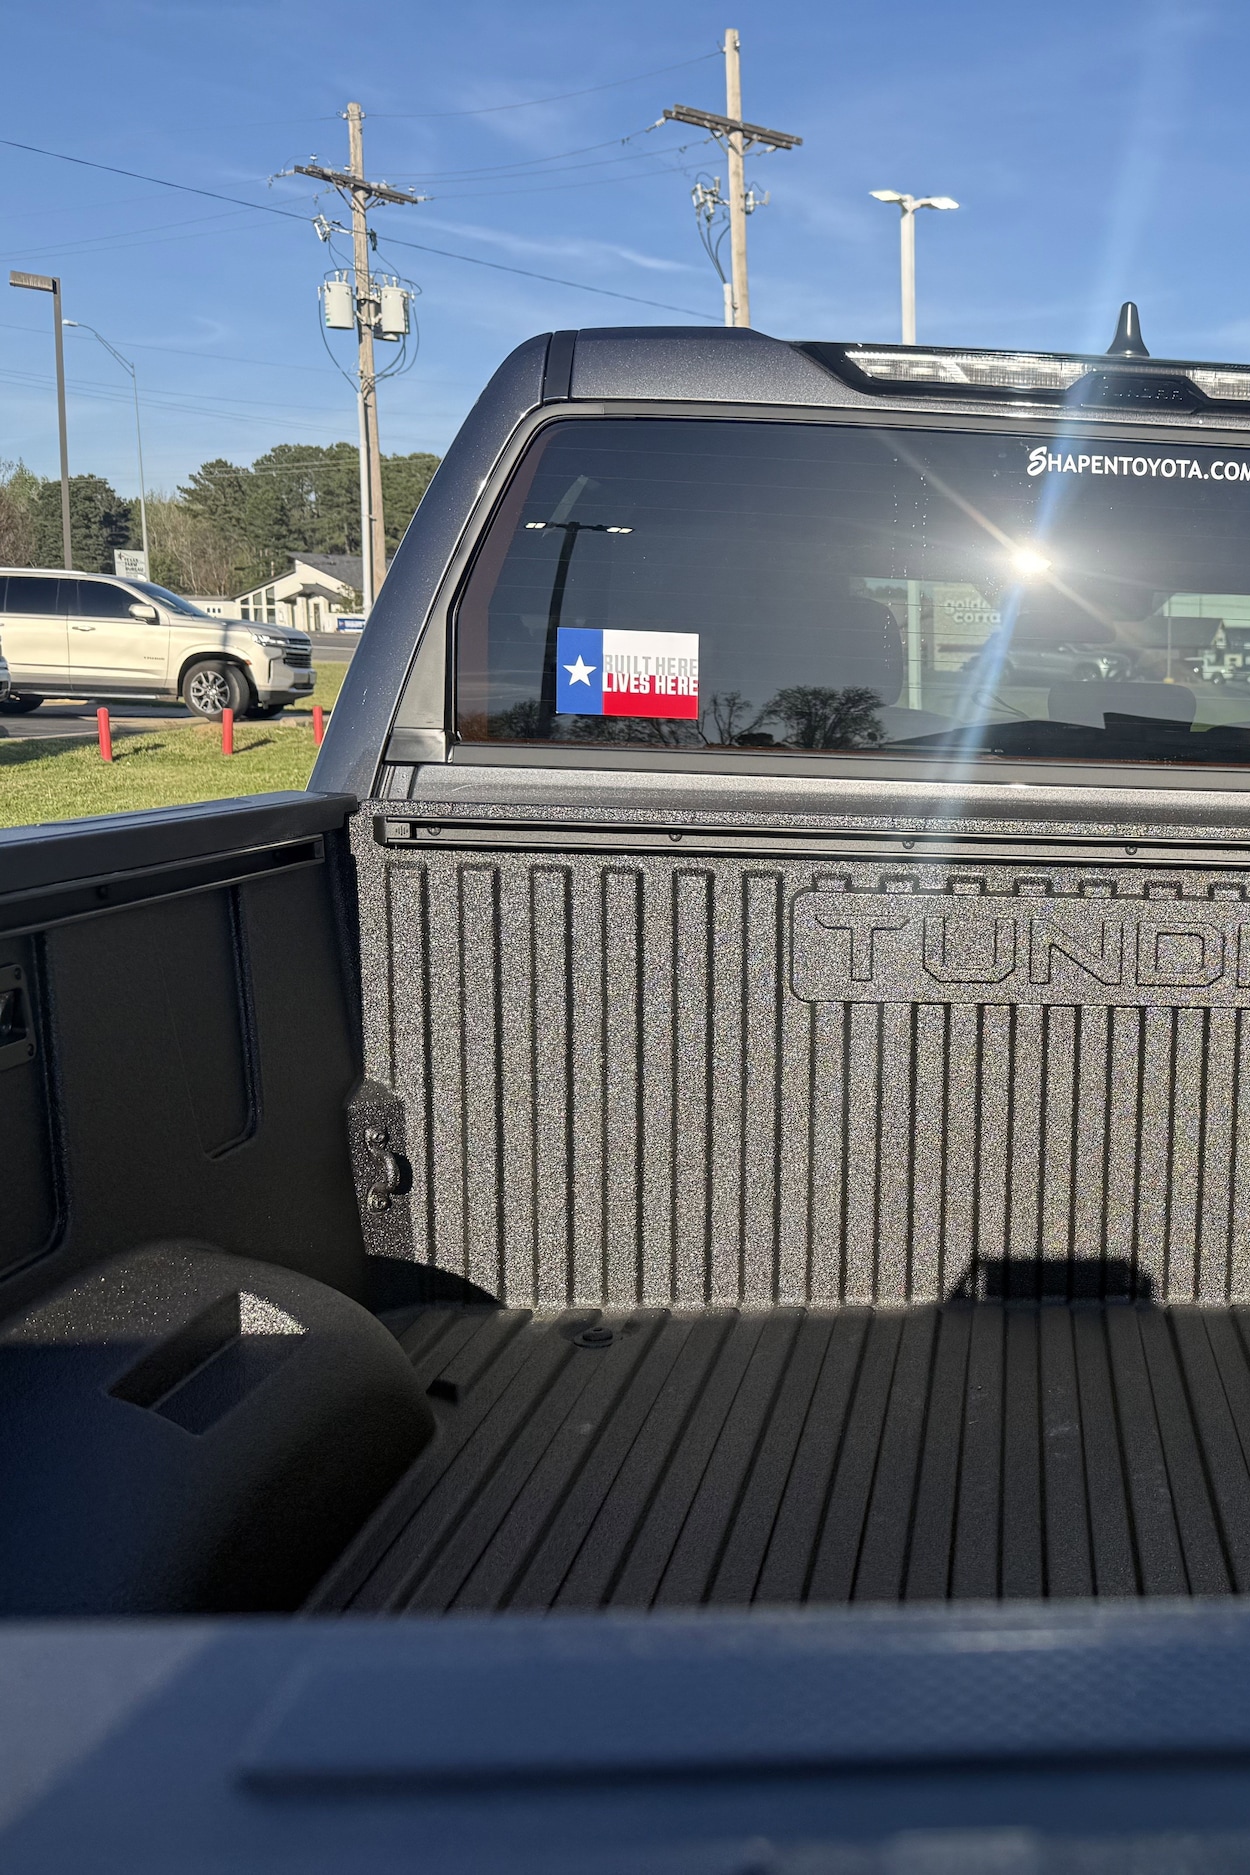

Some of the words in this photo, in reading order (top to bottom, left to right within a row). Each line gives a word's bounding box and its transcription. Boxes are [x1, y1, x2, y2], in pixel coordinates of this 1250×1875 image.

[953, 611, 1001, 623] corra
[604, 654, 652, 675] BUILT
[655, 657, 697, 677] HERE
[602, 672, 650, 694] LIVES
[654, 675, 698, 696] HERE
